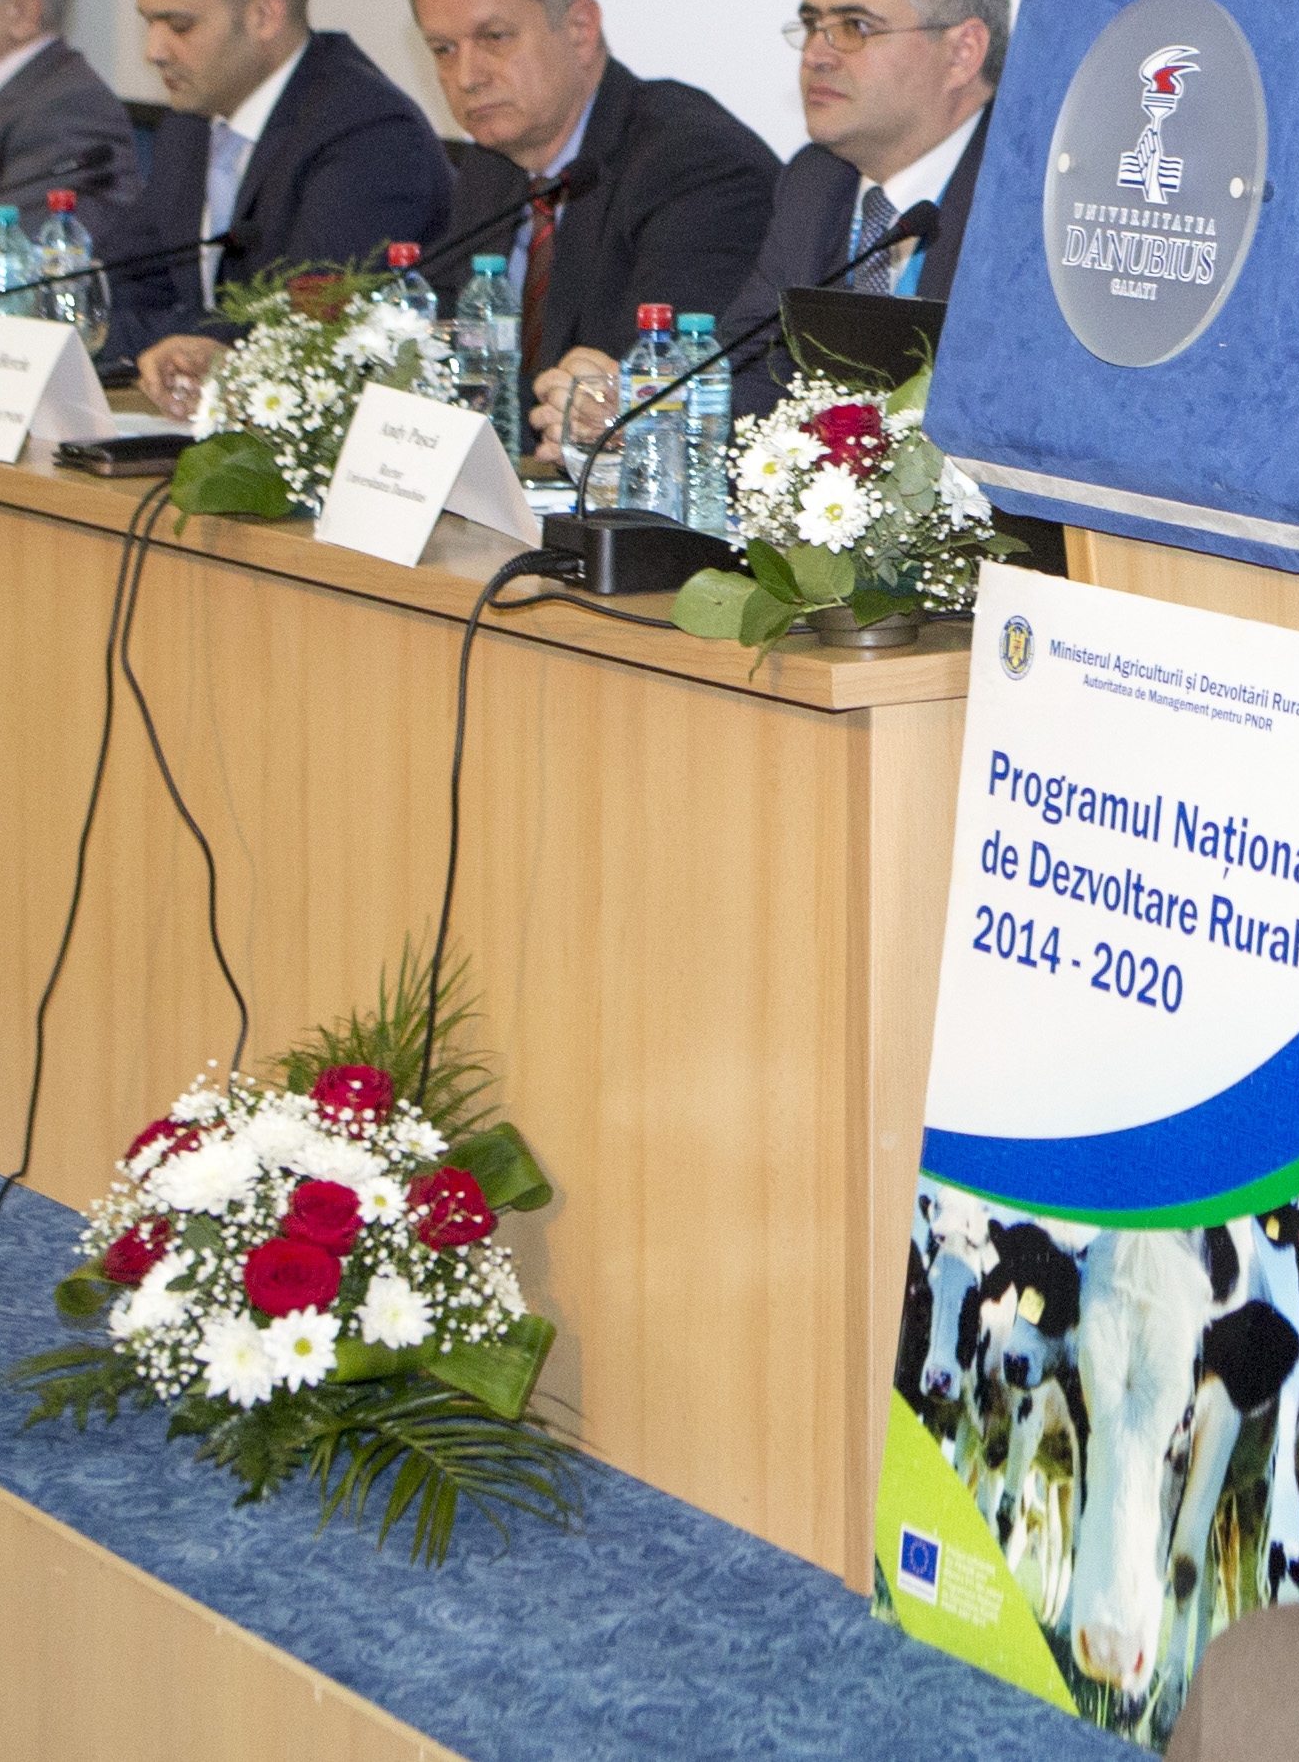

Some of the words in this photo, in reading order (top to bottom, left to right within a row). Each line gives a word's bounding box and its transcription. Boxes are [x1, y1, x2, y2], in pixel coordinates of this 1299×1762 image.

[1073, 202, 1216, 236] UNIVERSITATEA
[1062, 225, 1217, 285] DANUBIUS
[1049, 638, 1111, 670] Ministerul
[1113, 654, 1183, 688] Agriculturii
[1200, 675, 1269, 709] Dezvoltării
[1083, 673, 1133, 698] Autoritatea
[1135, 686, 1147, 701] de
[1148, 689, 1210, 717] Management
[1210, 706, 1242, 725] pentru
[1244, 713, 1273, 732] PNDR
[988, 749, 1162, 843] Programul
[980, 829, 1018, 879] de
[1029, 840, 1198, 936] Dezvoltare
[972, 904, 1061, 975] 2014
[1090, 941, 1184, 1014] 2020
